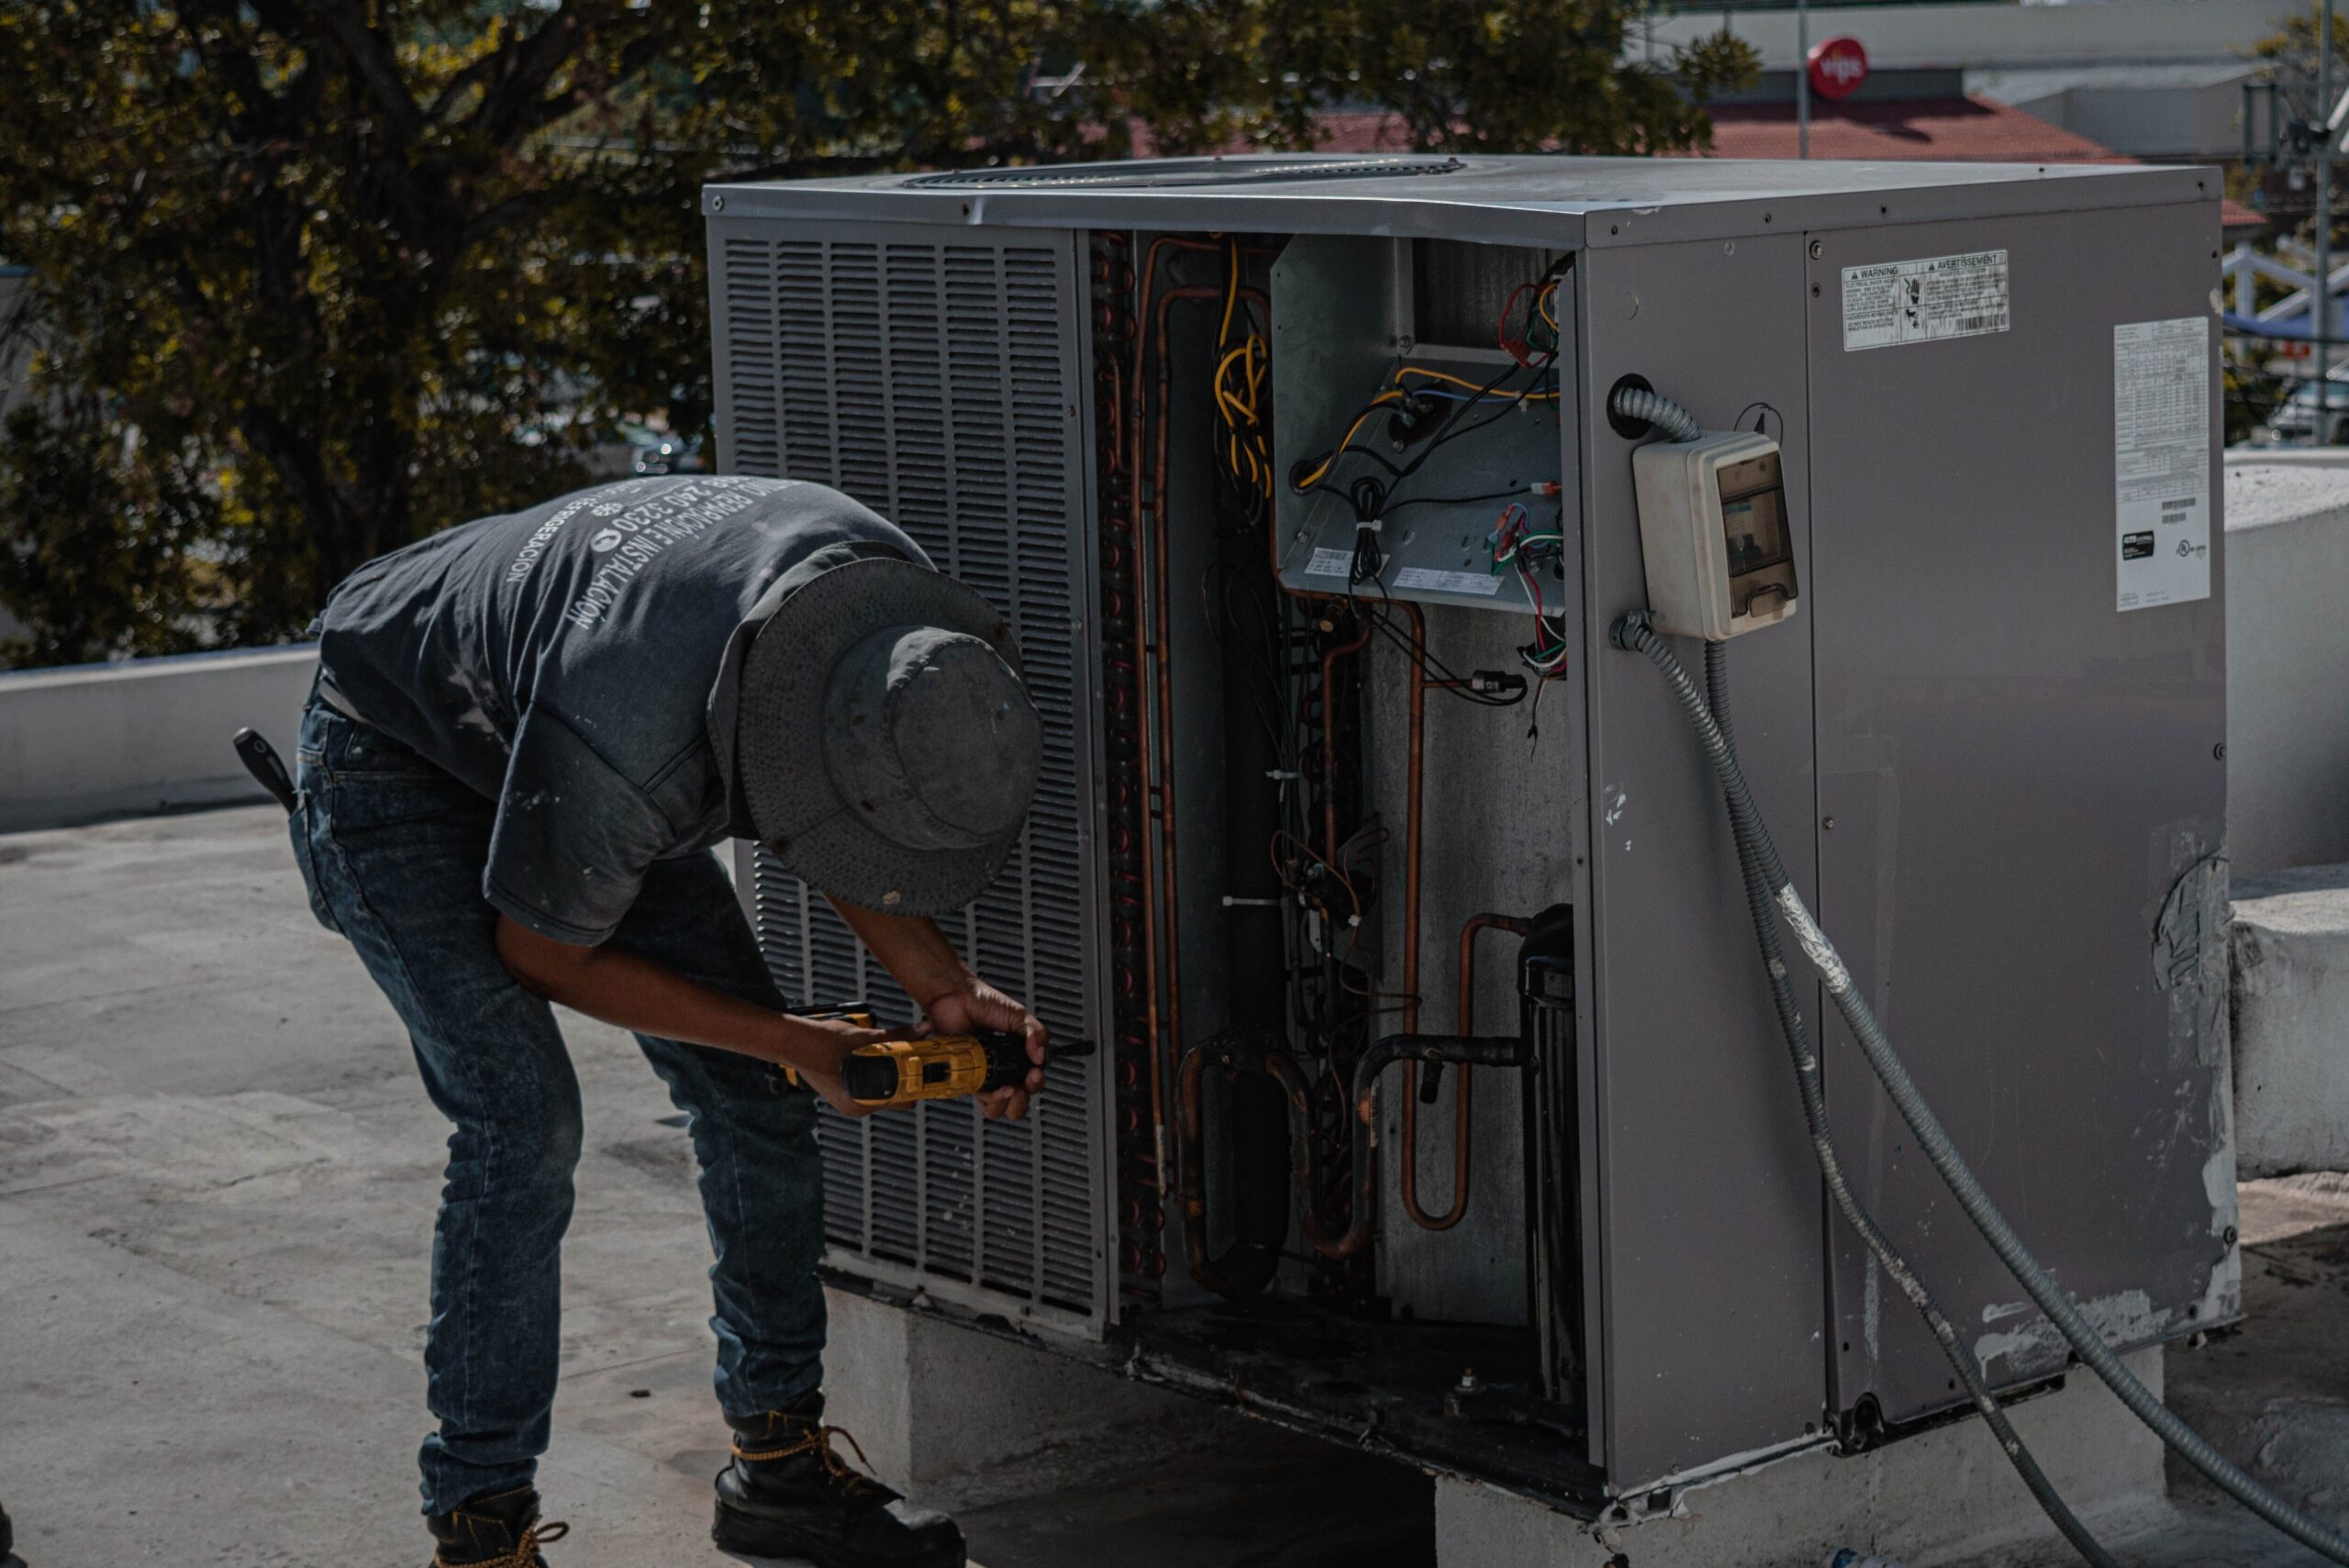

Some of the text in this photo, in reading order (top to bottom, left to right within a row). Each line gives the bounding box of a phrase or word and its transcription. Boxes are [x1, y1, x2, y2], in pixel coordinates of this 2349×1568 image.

[1820, 52, 1862, 86] vips
[1860, 265, 1898, 279] WARNING
[1936, 254, 1998, 271] AVERTISSEMENT
[663, 485, 713, 507] 240
[612, 502, 674, 532] 3230
[565, 490, 753, 630] REPARACIÓN E INSTALACIÓN
